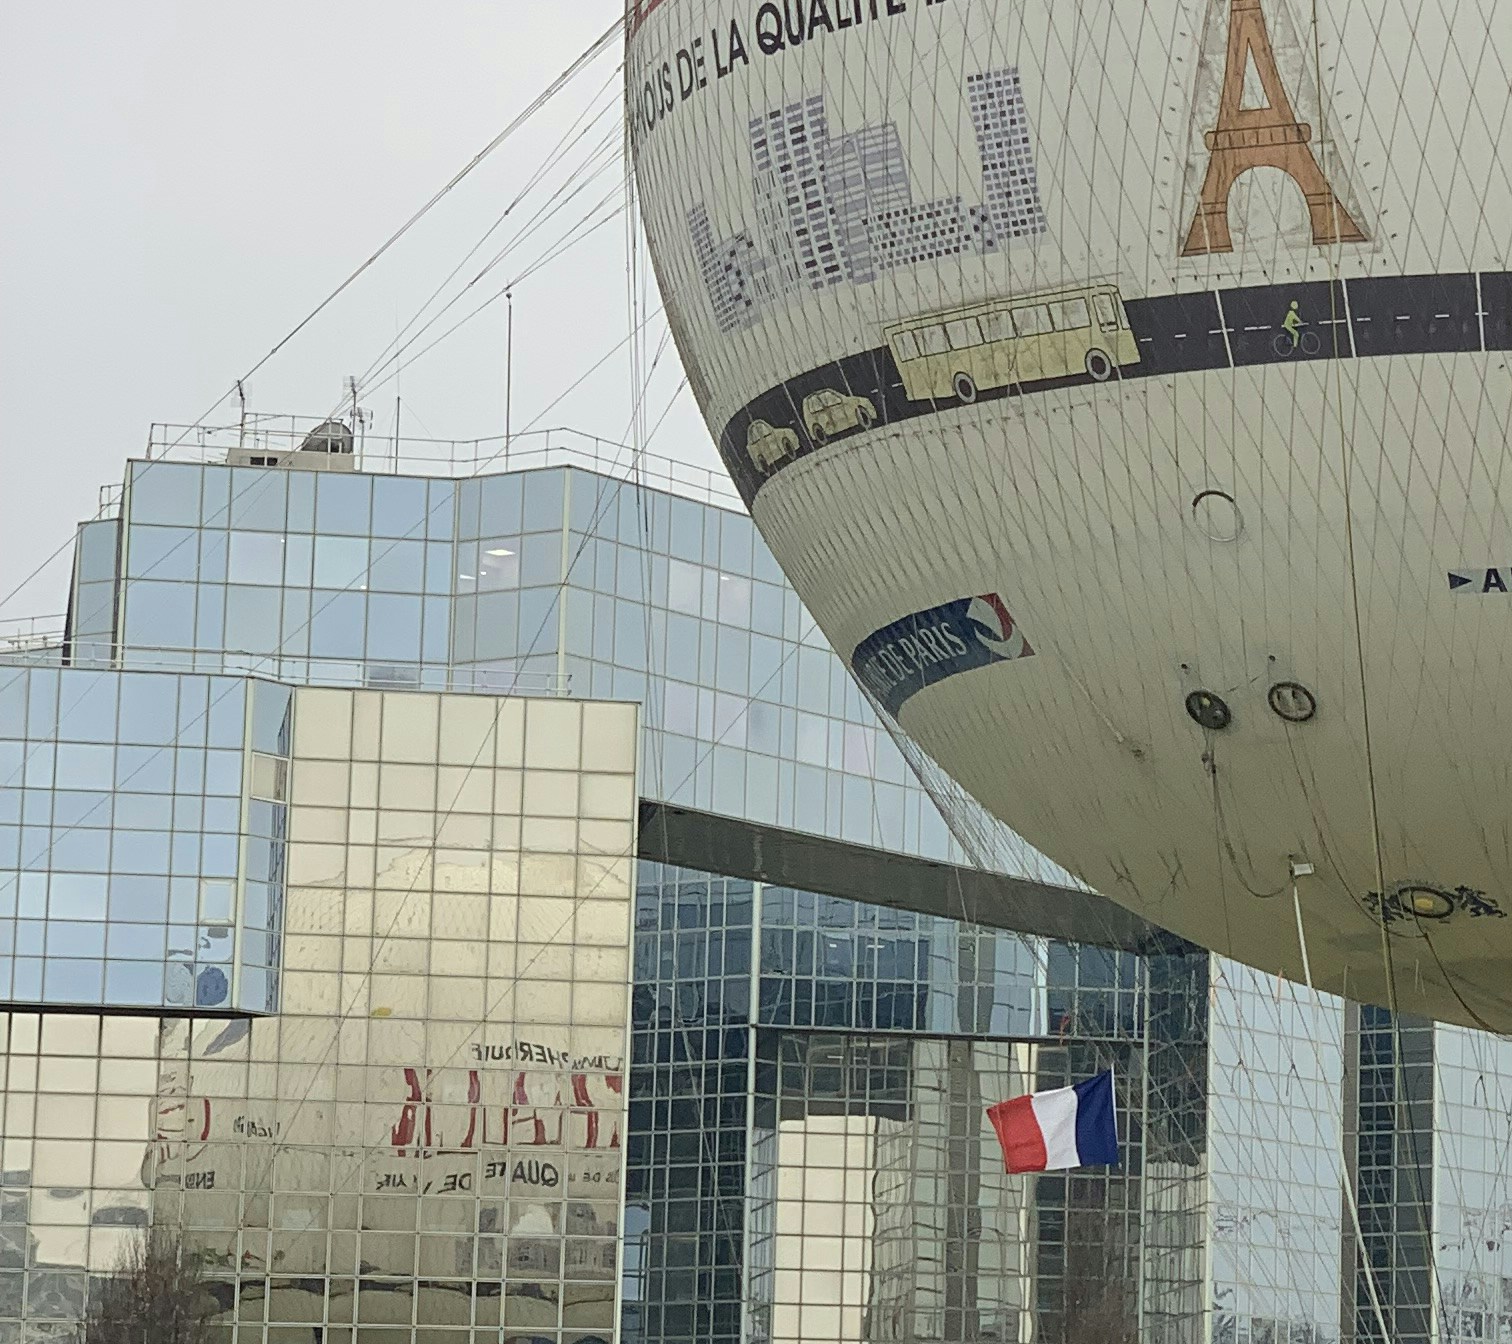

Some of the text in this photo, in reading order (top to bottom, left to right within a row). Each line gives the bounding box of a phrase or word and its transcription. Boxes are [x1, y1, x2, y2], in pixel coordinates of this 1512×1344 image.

[675, 36, 708, 102] DE
[711, 18, 750, 79] LA
[878, 643, 914, 681] DE
[898, 622, 968, 670] PARIS
